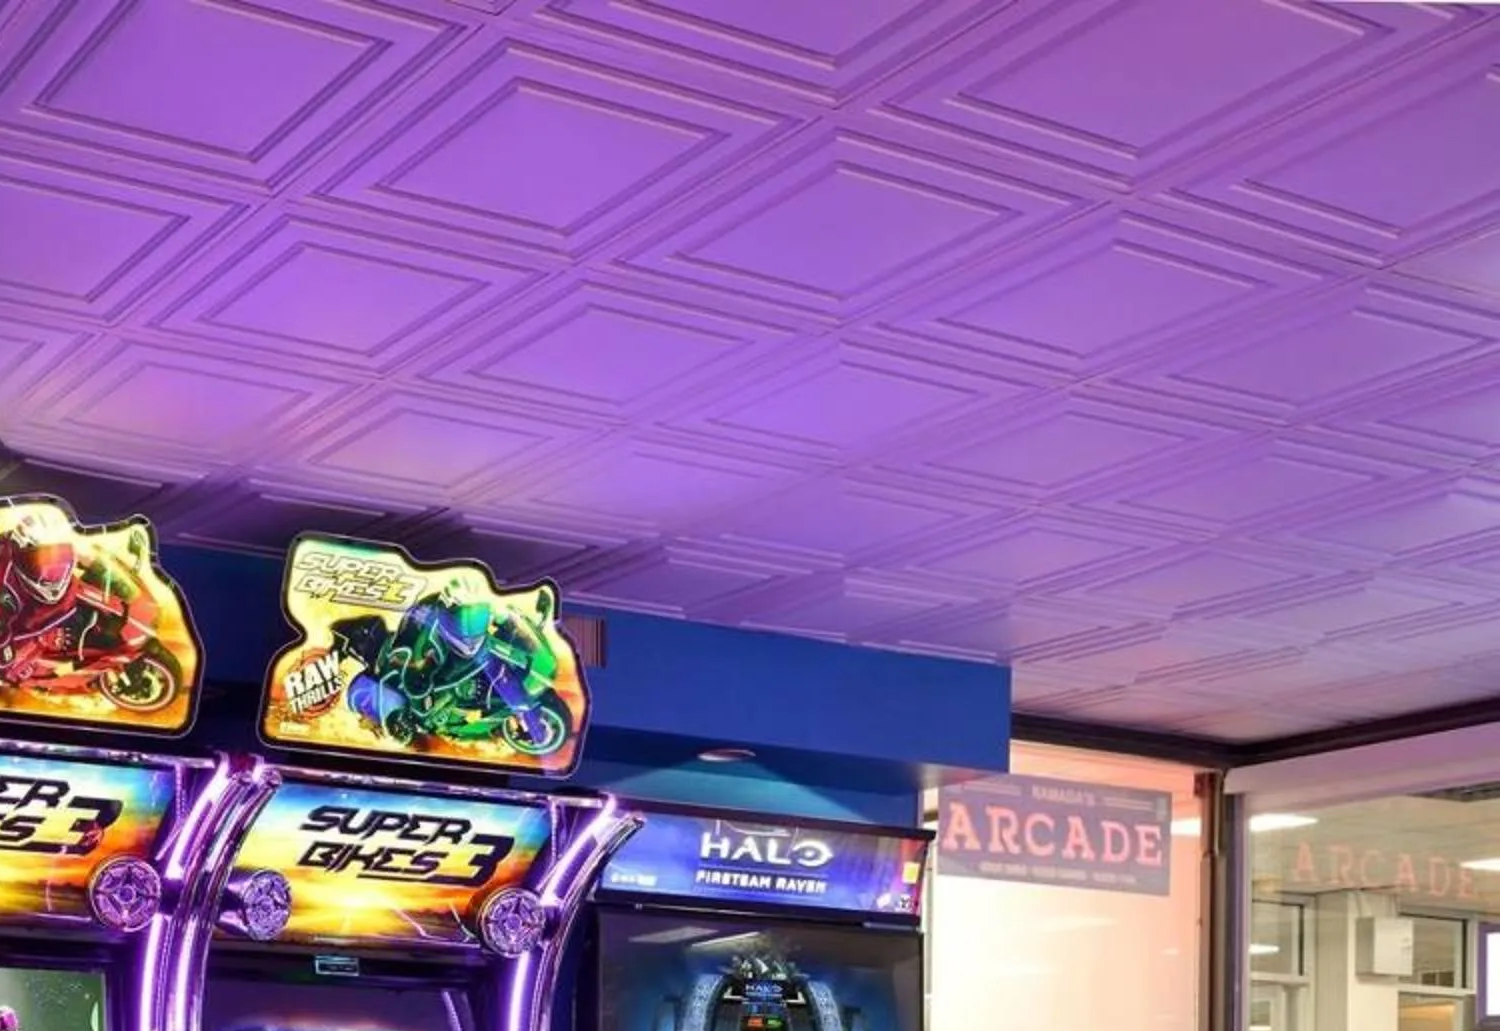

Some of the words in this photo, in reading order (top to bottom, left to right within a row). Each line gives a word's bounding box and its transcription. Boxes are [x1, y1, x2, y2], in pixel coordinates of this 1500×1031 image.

[293, 553, 402, 583] SUPER
[295, 574, 388, 600] BIKES
[284, 651, 339, 698] RAW
[291, 676, 343, 714] THRILLS
[67, 796, 123, 855] 3
[299, 805, 472, 845] SUPER
[942, 802, 1162, 867] ARCADE
[297, 841, 448, 873] BIKES
[468, 833, 514, 888] 3
[701, 832, 833, 867] HALO
[1293, 841, 1474, 898] ARCADE
[695, 870, 771, 889] FIRETEAM
[776, 877, 827, 893] RAVEN
